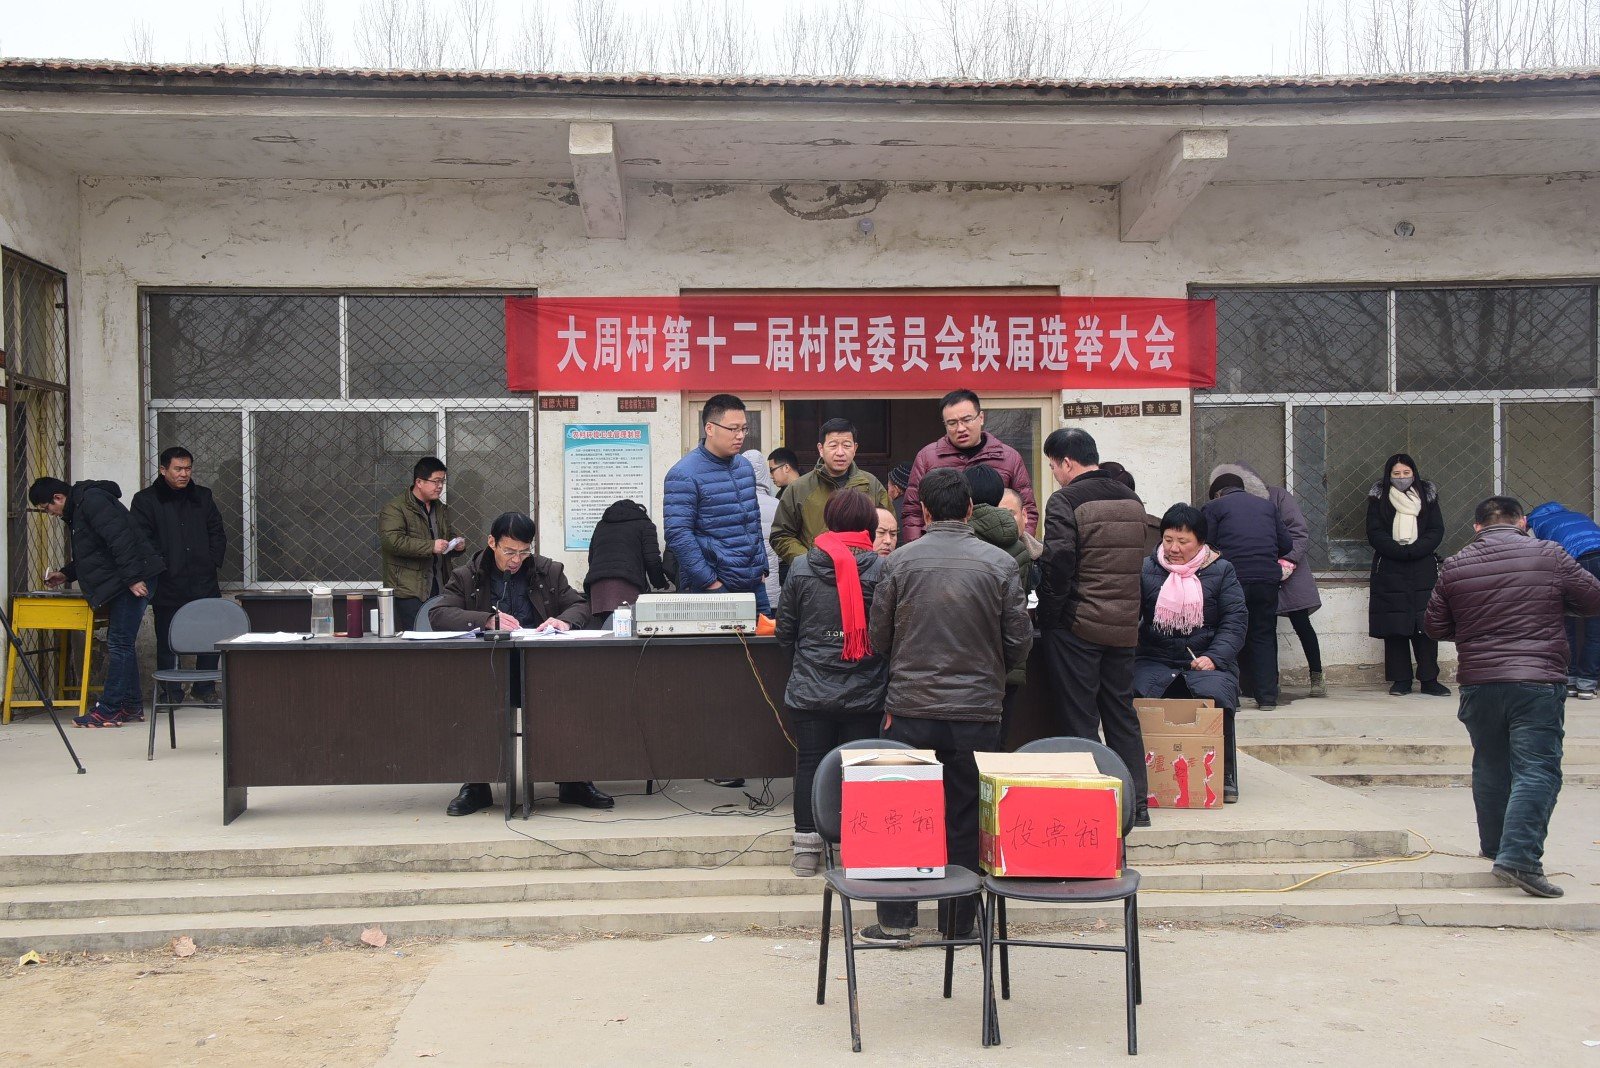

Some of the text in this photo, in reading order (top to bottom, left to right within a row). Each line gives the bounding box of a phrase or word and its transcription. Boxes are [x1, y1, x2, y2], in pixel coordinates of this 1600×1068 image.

[556, 314, 1175, 373] 大周村第十二届村民委员会换届选举大会
[541, 398, 576, 409] 道德大讲堂
[1067, 404, 1099, 415] 计生协会
[1105, 405, 1139, 416] 人口学校
[849, 807, 936, 836] 投票箱
[1005, 813, 1103, 851] 投票箱
